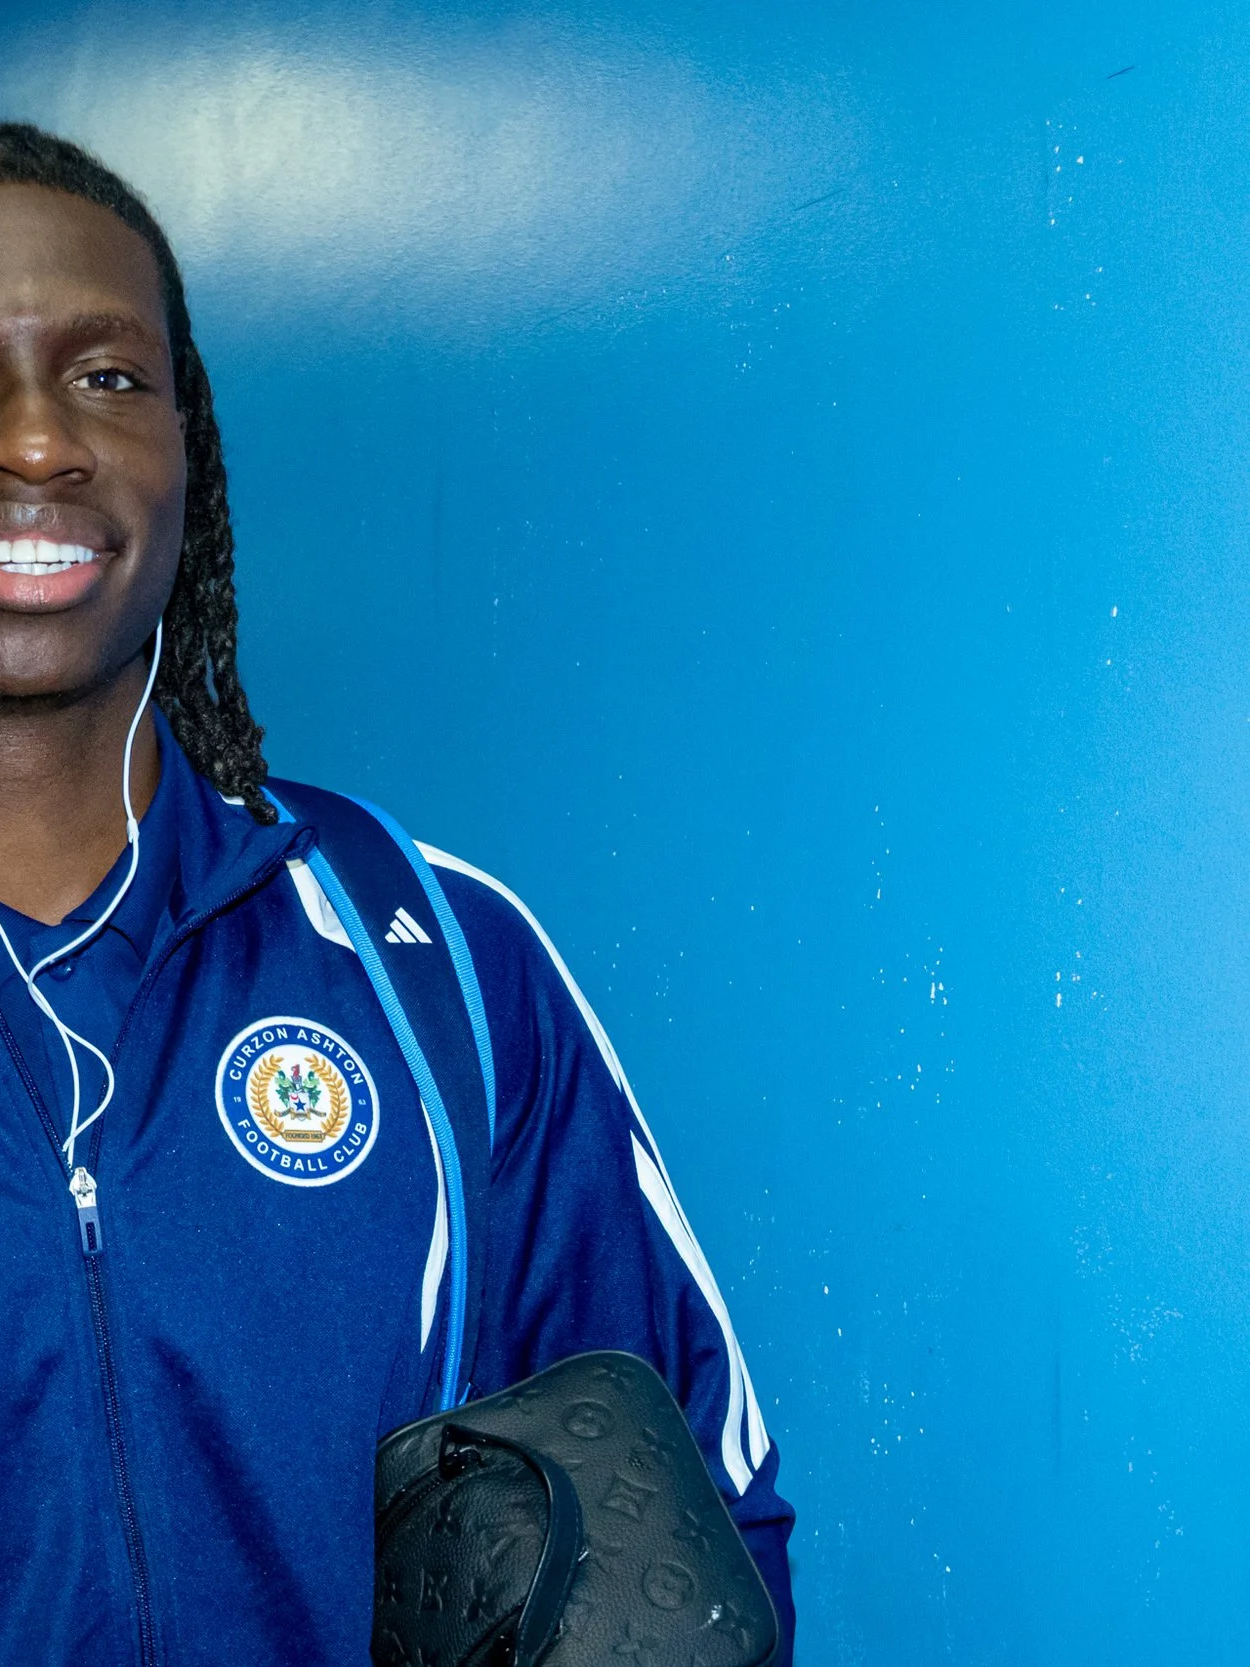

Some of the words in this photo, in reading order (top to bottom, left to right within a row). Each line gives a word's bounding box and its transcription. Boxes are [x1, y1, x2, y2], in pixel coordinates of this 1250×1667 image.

[229, 1027, 288, 1081] CURZON
[297, 1028, 364, 1085] ASHTON
[237, 1119, 328, 1172] FOOTBALL
[333, 1122, 367, 1163] CLUB
